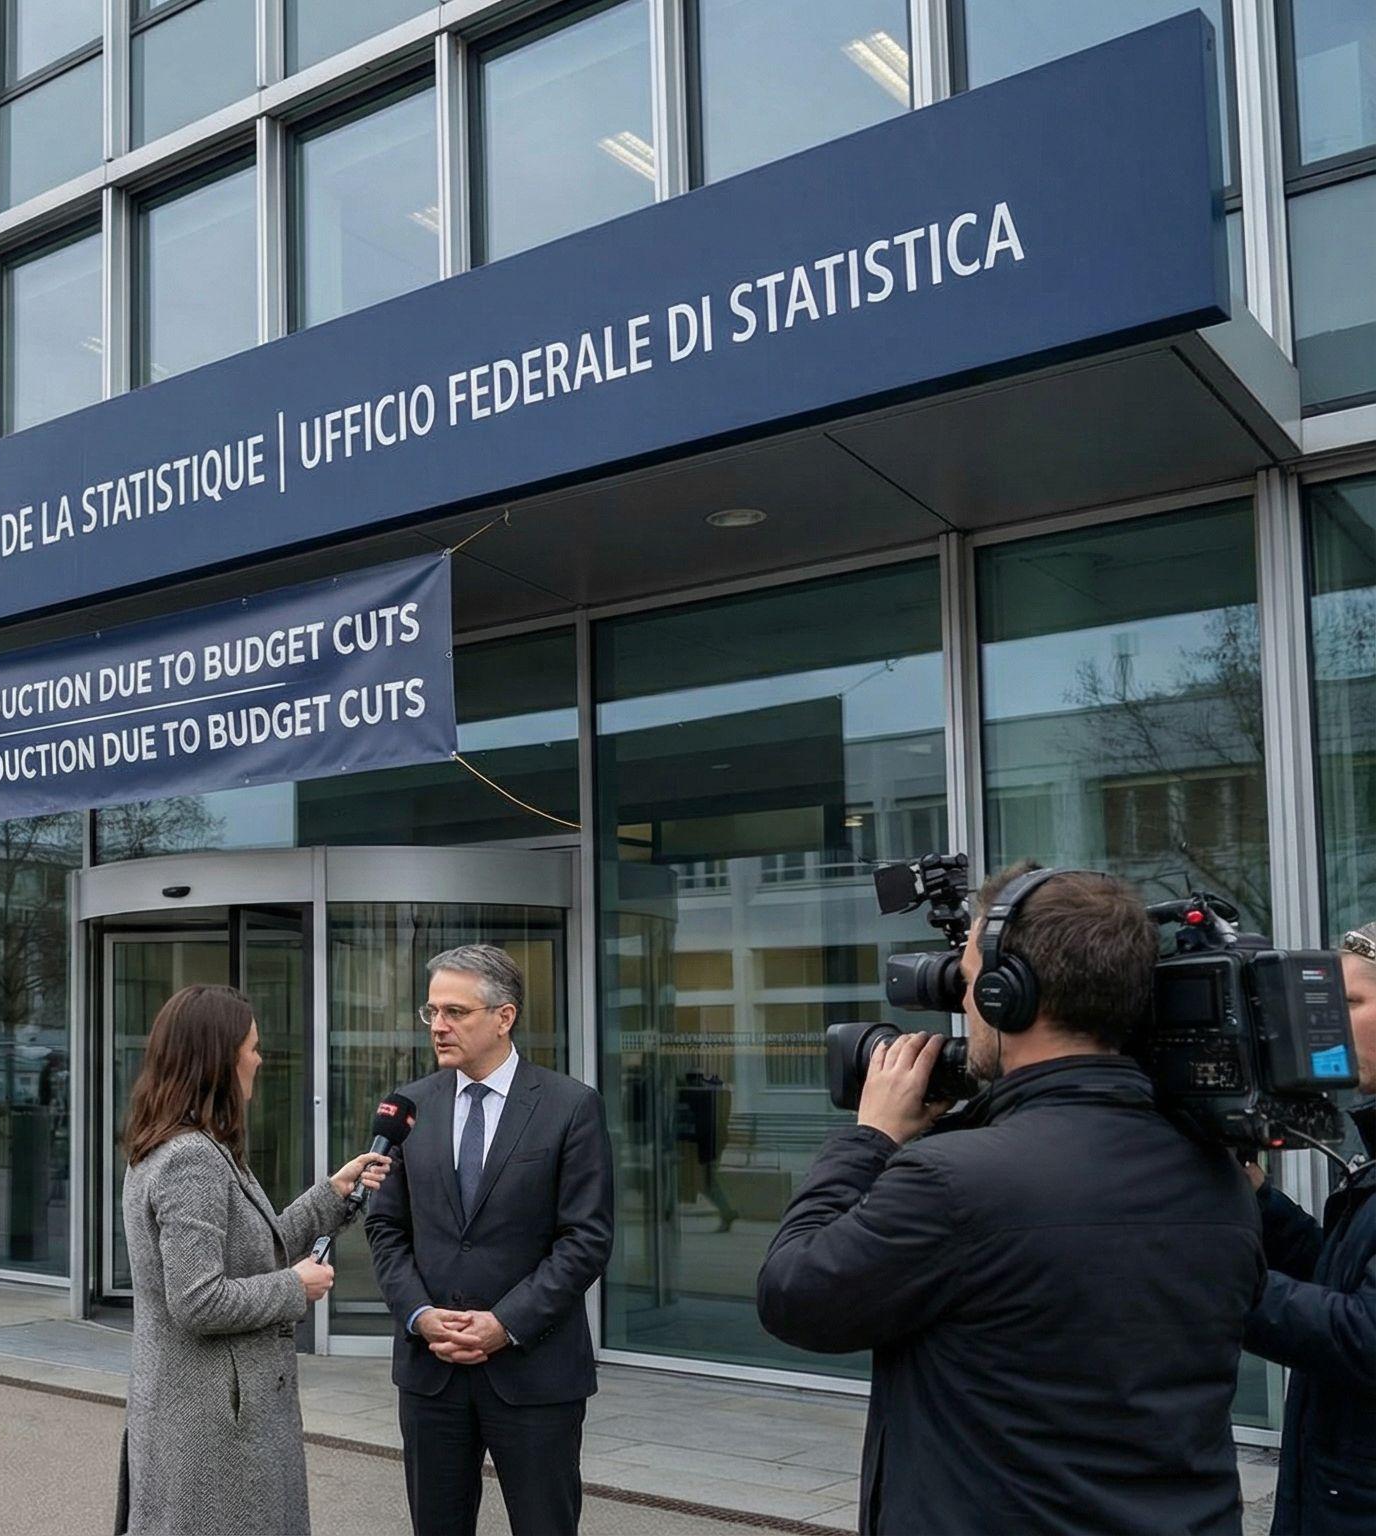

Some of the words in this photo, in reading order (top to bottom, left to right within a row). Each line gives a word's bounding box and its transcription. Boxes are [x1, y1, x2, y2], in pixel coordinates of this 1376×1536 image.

[1, 505, 34, 557] DE
[41, 495, 75, 545] LA
[81, 433, 265, 533] STATISTIQUE
[300, 384, 435, 469] UFFICIO
[448, 314, 653, 426] FEDERALE
[667, 295, 713, 362] DI
[729, 201, 1025, 343] STATISTICA
[98, 660, 153, 702] DUE
[159, 651, 196, 689] TO
[203, 622, 325, 681] BUDGET
[332, 602, 420, 655] CUTS
[102, 724, 158, 767] DUE
[162, 718, 201, 756] TO
[208, 694, 331, 750] BUDGET
[338, 677, 426, 728] CUTS
